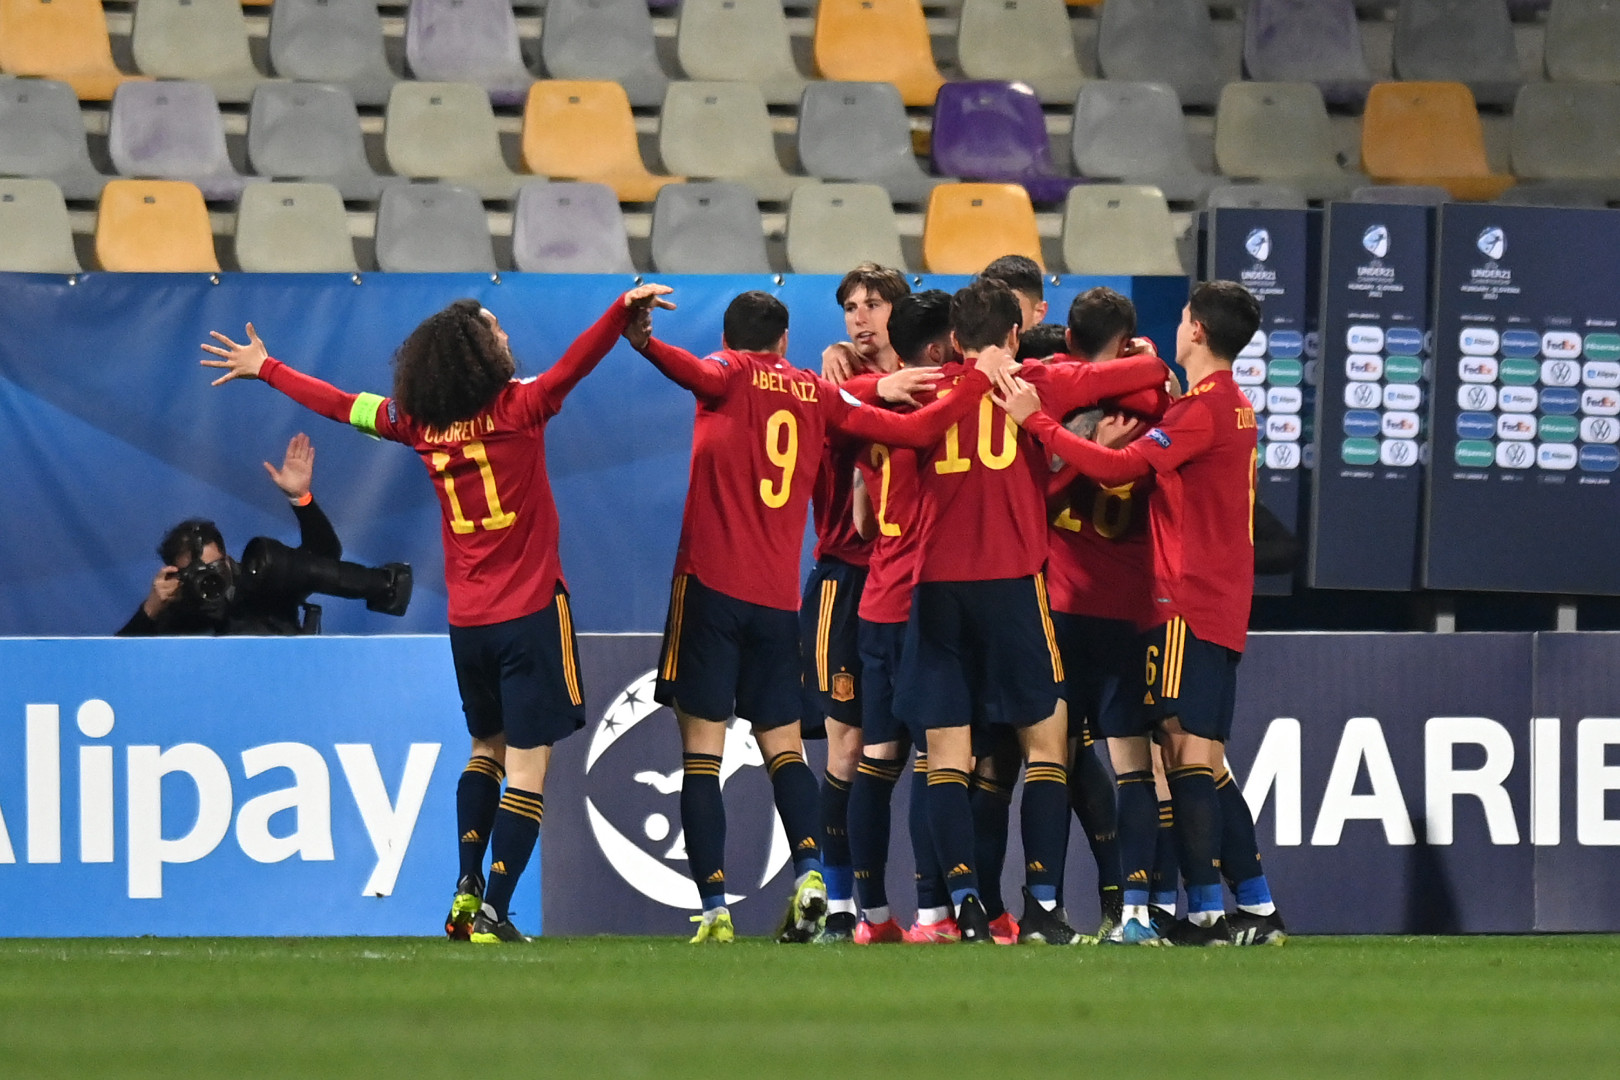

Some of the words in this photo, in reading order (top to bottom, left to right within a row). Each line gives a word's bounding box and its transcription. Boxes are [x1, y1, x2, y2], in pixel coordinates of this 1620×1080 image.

[1546, 339, 1576, 350] FedEx
[1236, 365, 1262, 377] FedEx
[1350, 361, 1378, 373] FedEx
[1463, 364, 1493, 376] FedEx
[1586, 396, 1616, 408] FedEx
[1270, 421, 1297, 434] FedEx
[1386, 419, 1415, 431] FedEx
[1502, 421, 1532, 432] FedEx
[934, 388, 1019, 475] 10
[759, 409, 798, 508] 9
[431, 439, 517, 535] 11
[1146, 644, 1159, 686] 6
[0, 699, 441, 900] lipay
